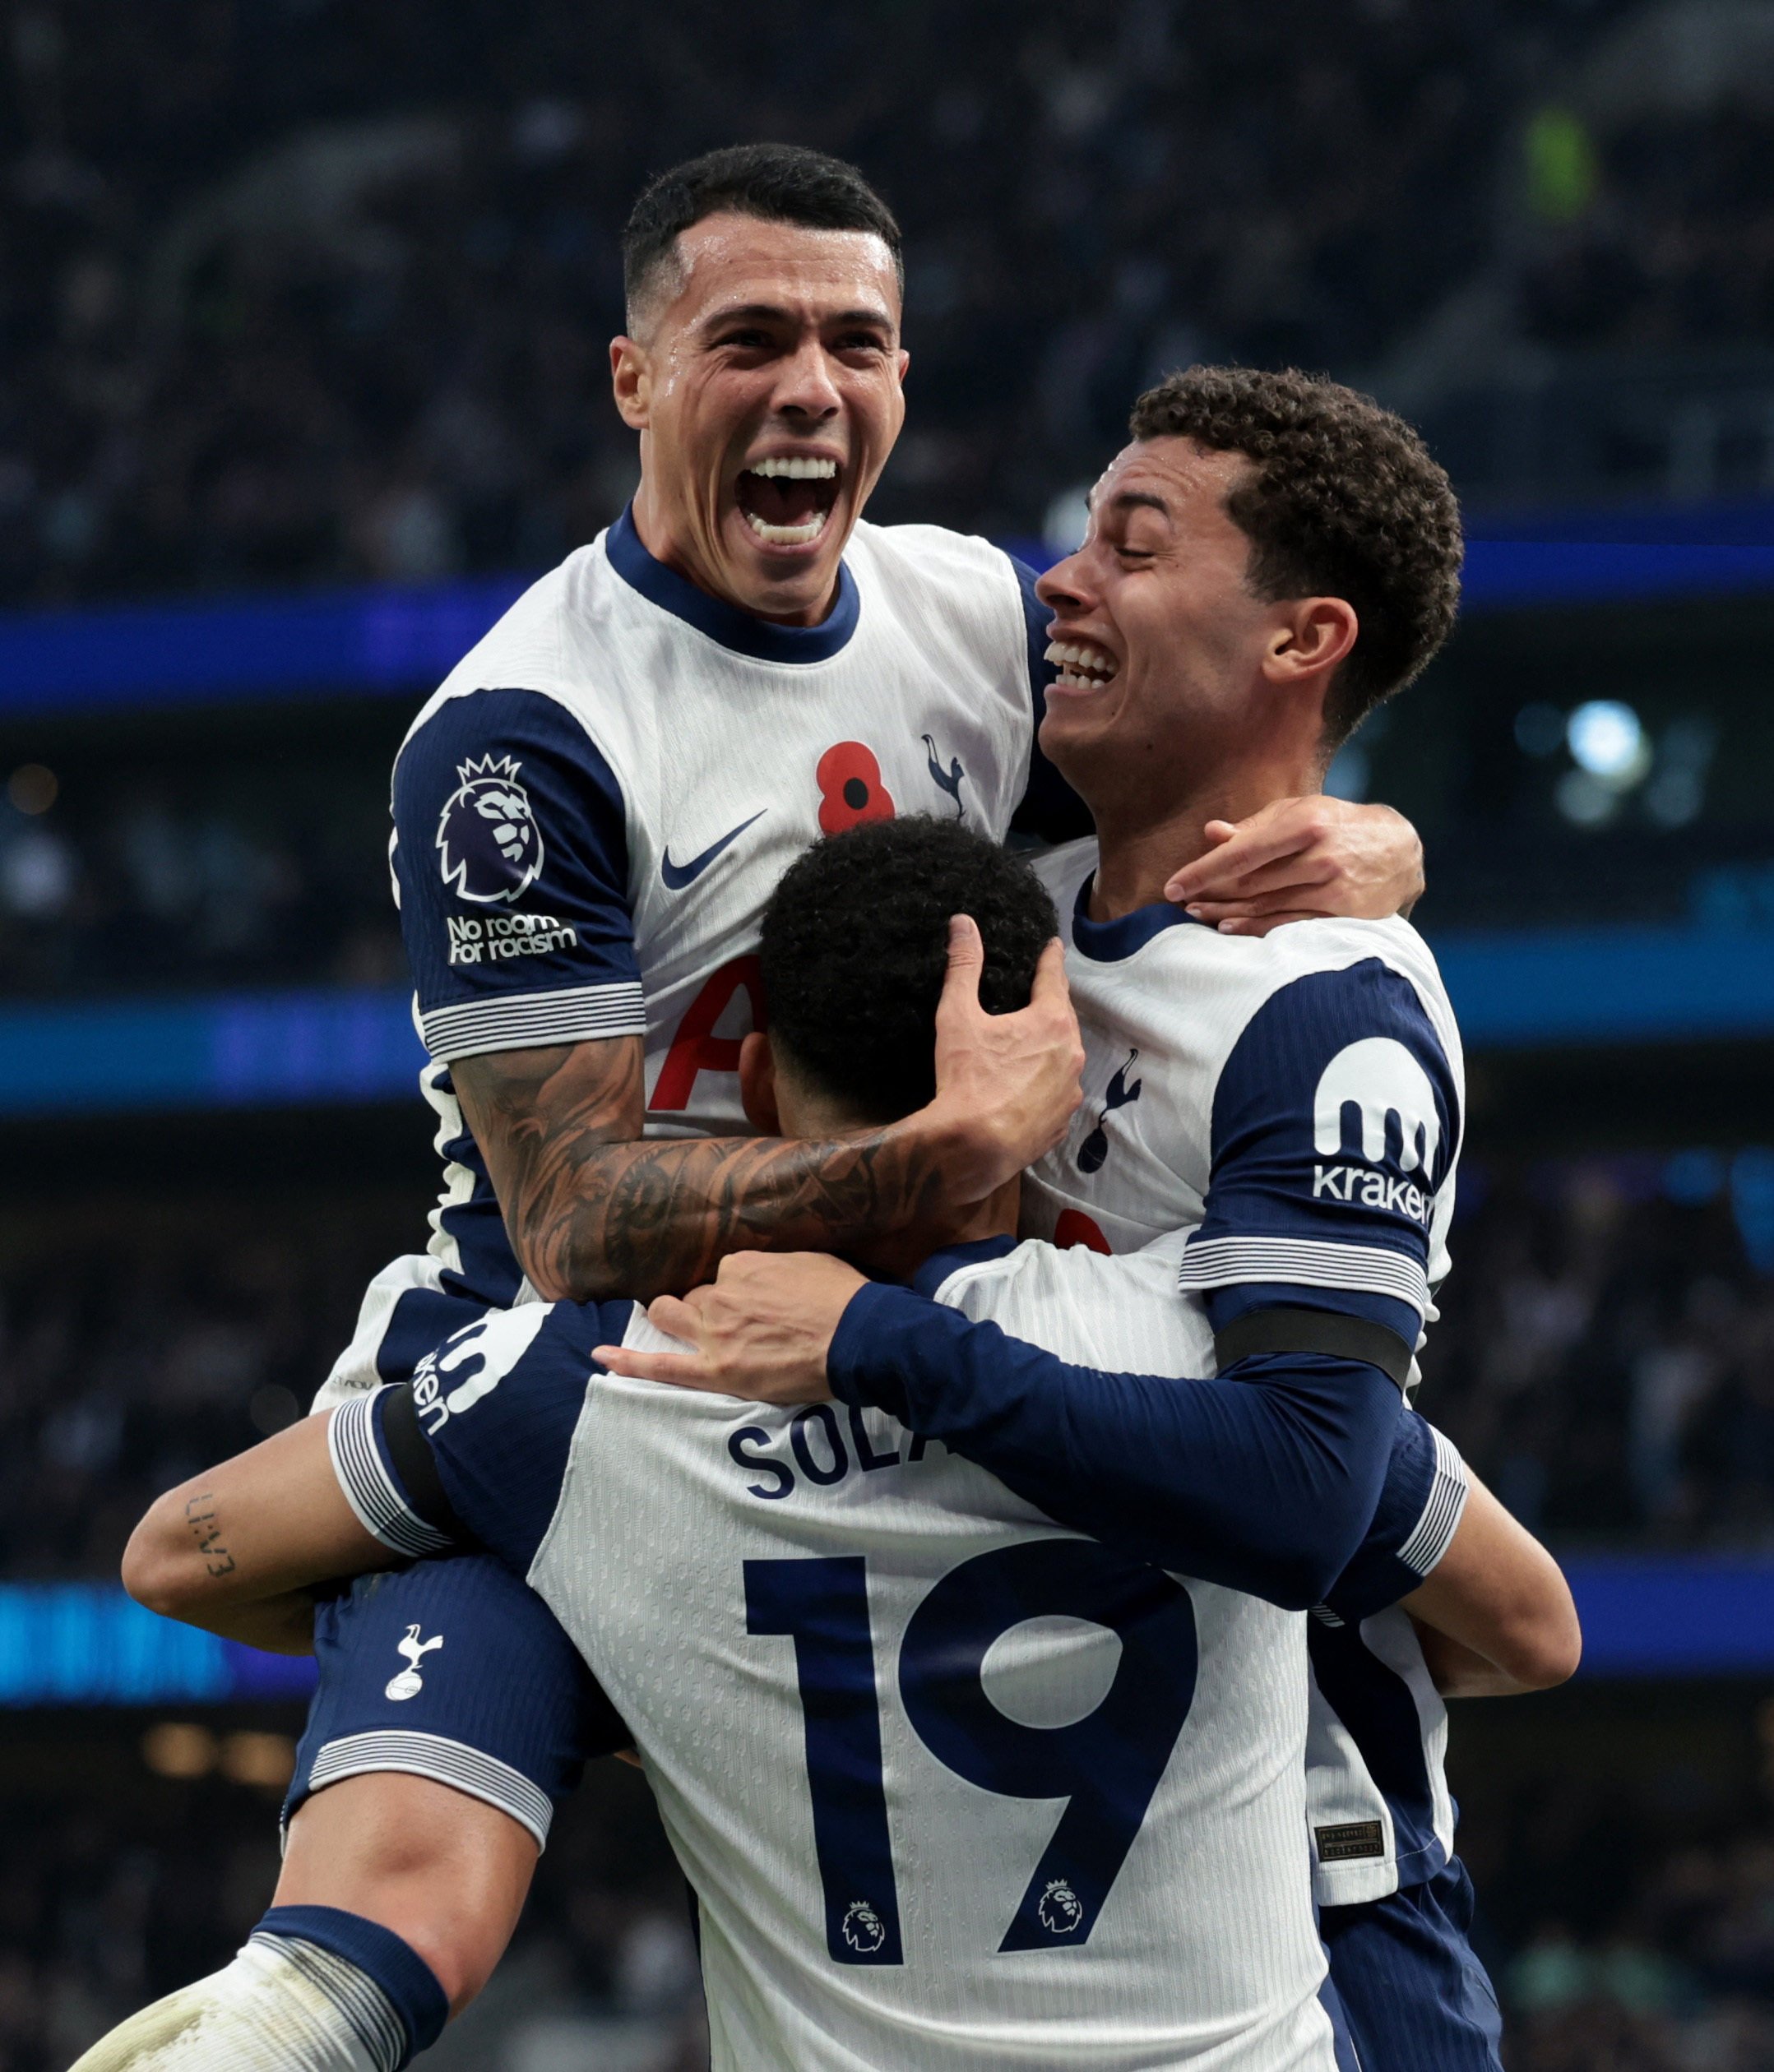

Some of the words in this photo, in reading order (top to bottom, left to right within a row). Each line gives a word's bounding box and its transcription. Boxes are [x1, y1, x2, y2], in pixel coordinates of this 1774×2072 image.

[447, 916, 482, 941] No
[485, 914, 560, 937] room
[450, 940, 484, 964] for
[488, 927, 577, 960] racism
[743, 1538, 1199, 1965] 19
